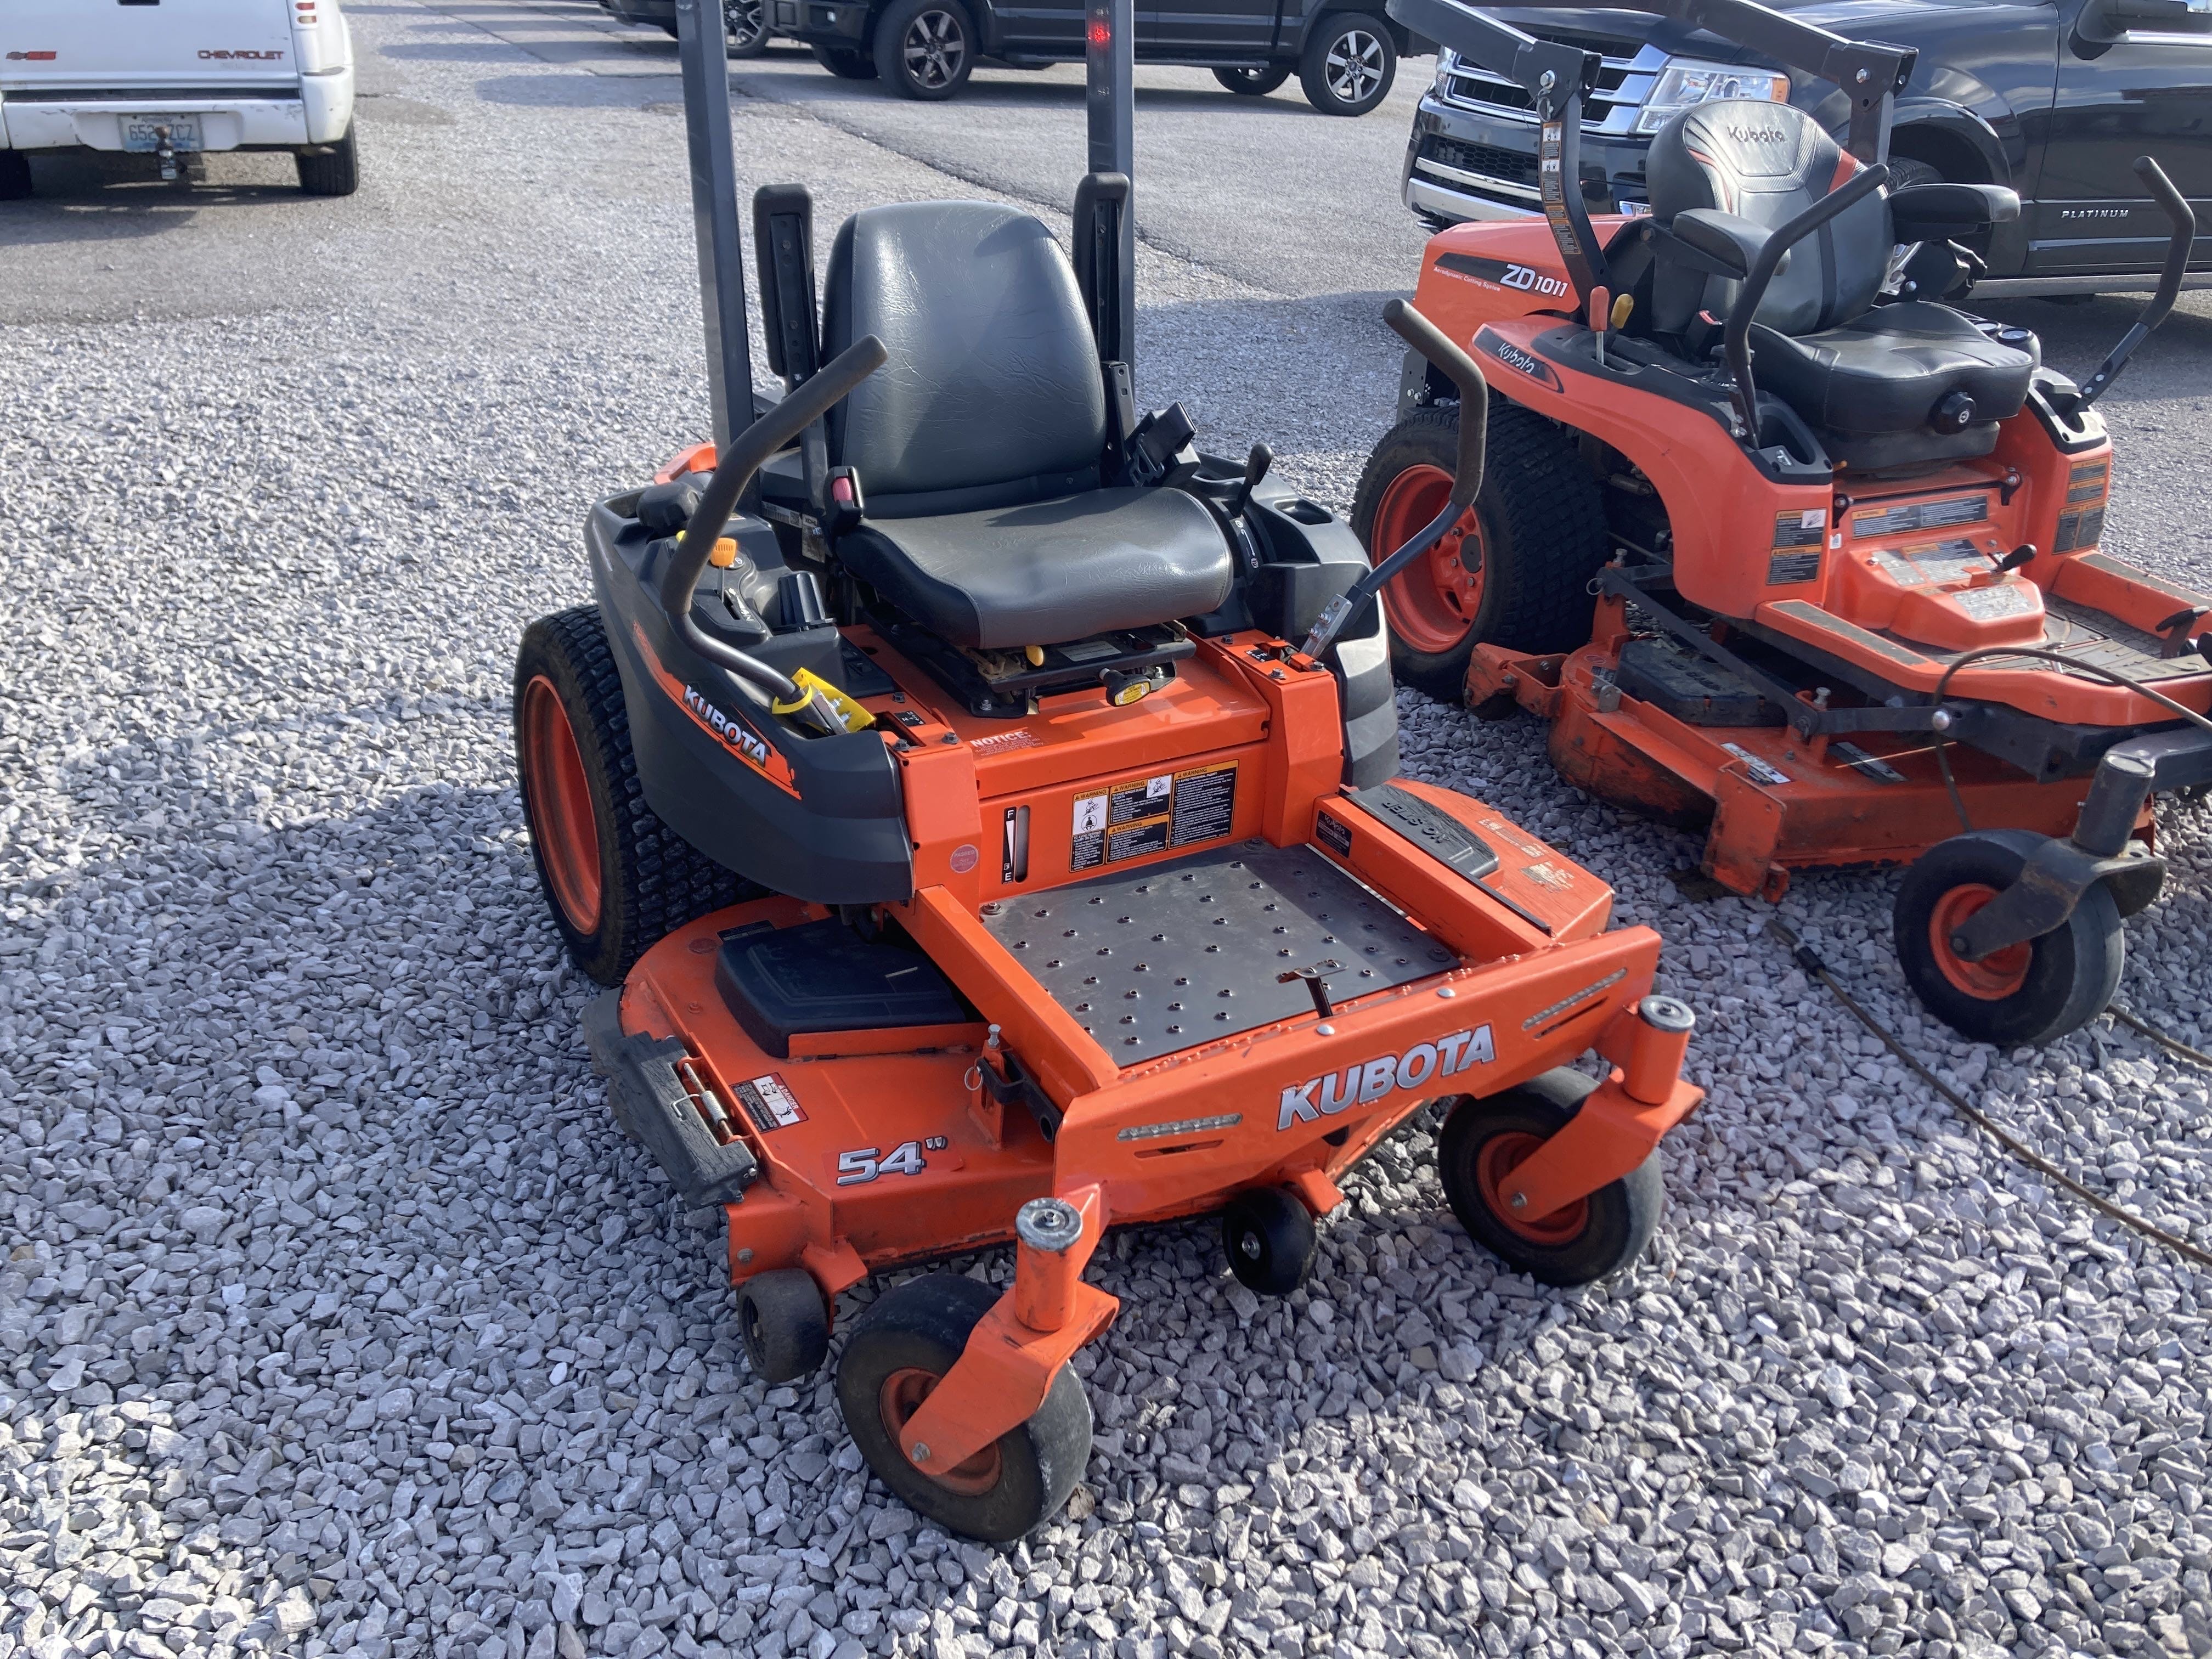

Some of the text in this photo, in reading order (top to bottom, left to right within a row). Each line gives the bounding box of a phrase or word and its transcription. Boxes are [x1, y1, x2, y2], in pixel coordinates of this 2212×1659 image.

[197, 50, 284, 60] CHEVROLET
[1727, 127, 1786, 143] Kubota
[2061, 210, 2129, 218] PLATINUM
[1433, 267, 1500, 292] Aerodynamic Cutting System
[1498, 342, 1535, 374] Kubota
[683, 684, 766, 769] KUBOTA
[970, 731, 1032, 747] NOTICE:
[1183, 768, 1207, 777] WARNING
[1119, 781, 1145, 791] WARNING
[1081, 789, 1107, 799] WARNING
[1007, 809, 1014, 819] F
[1117, 822, 1142, 831] WARNING
[1005, 872, 1012, 881] E
[1277, 1024, 1496, 1132] KUBOTA
[781, 1088, 799, 1109] DANGER
[837, 1136, 948, 1186] 54"
